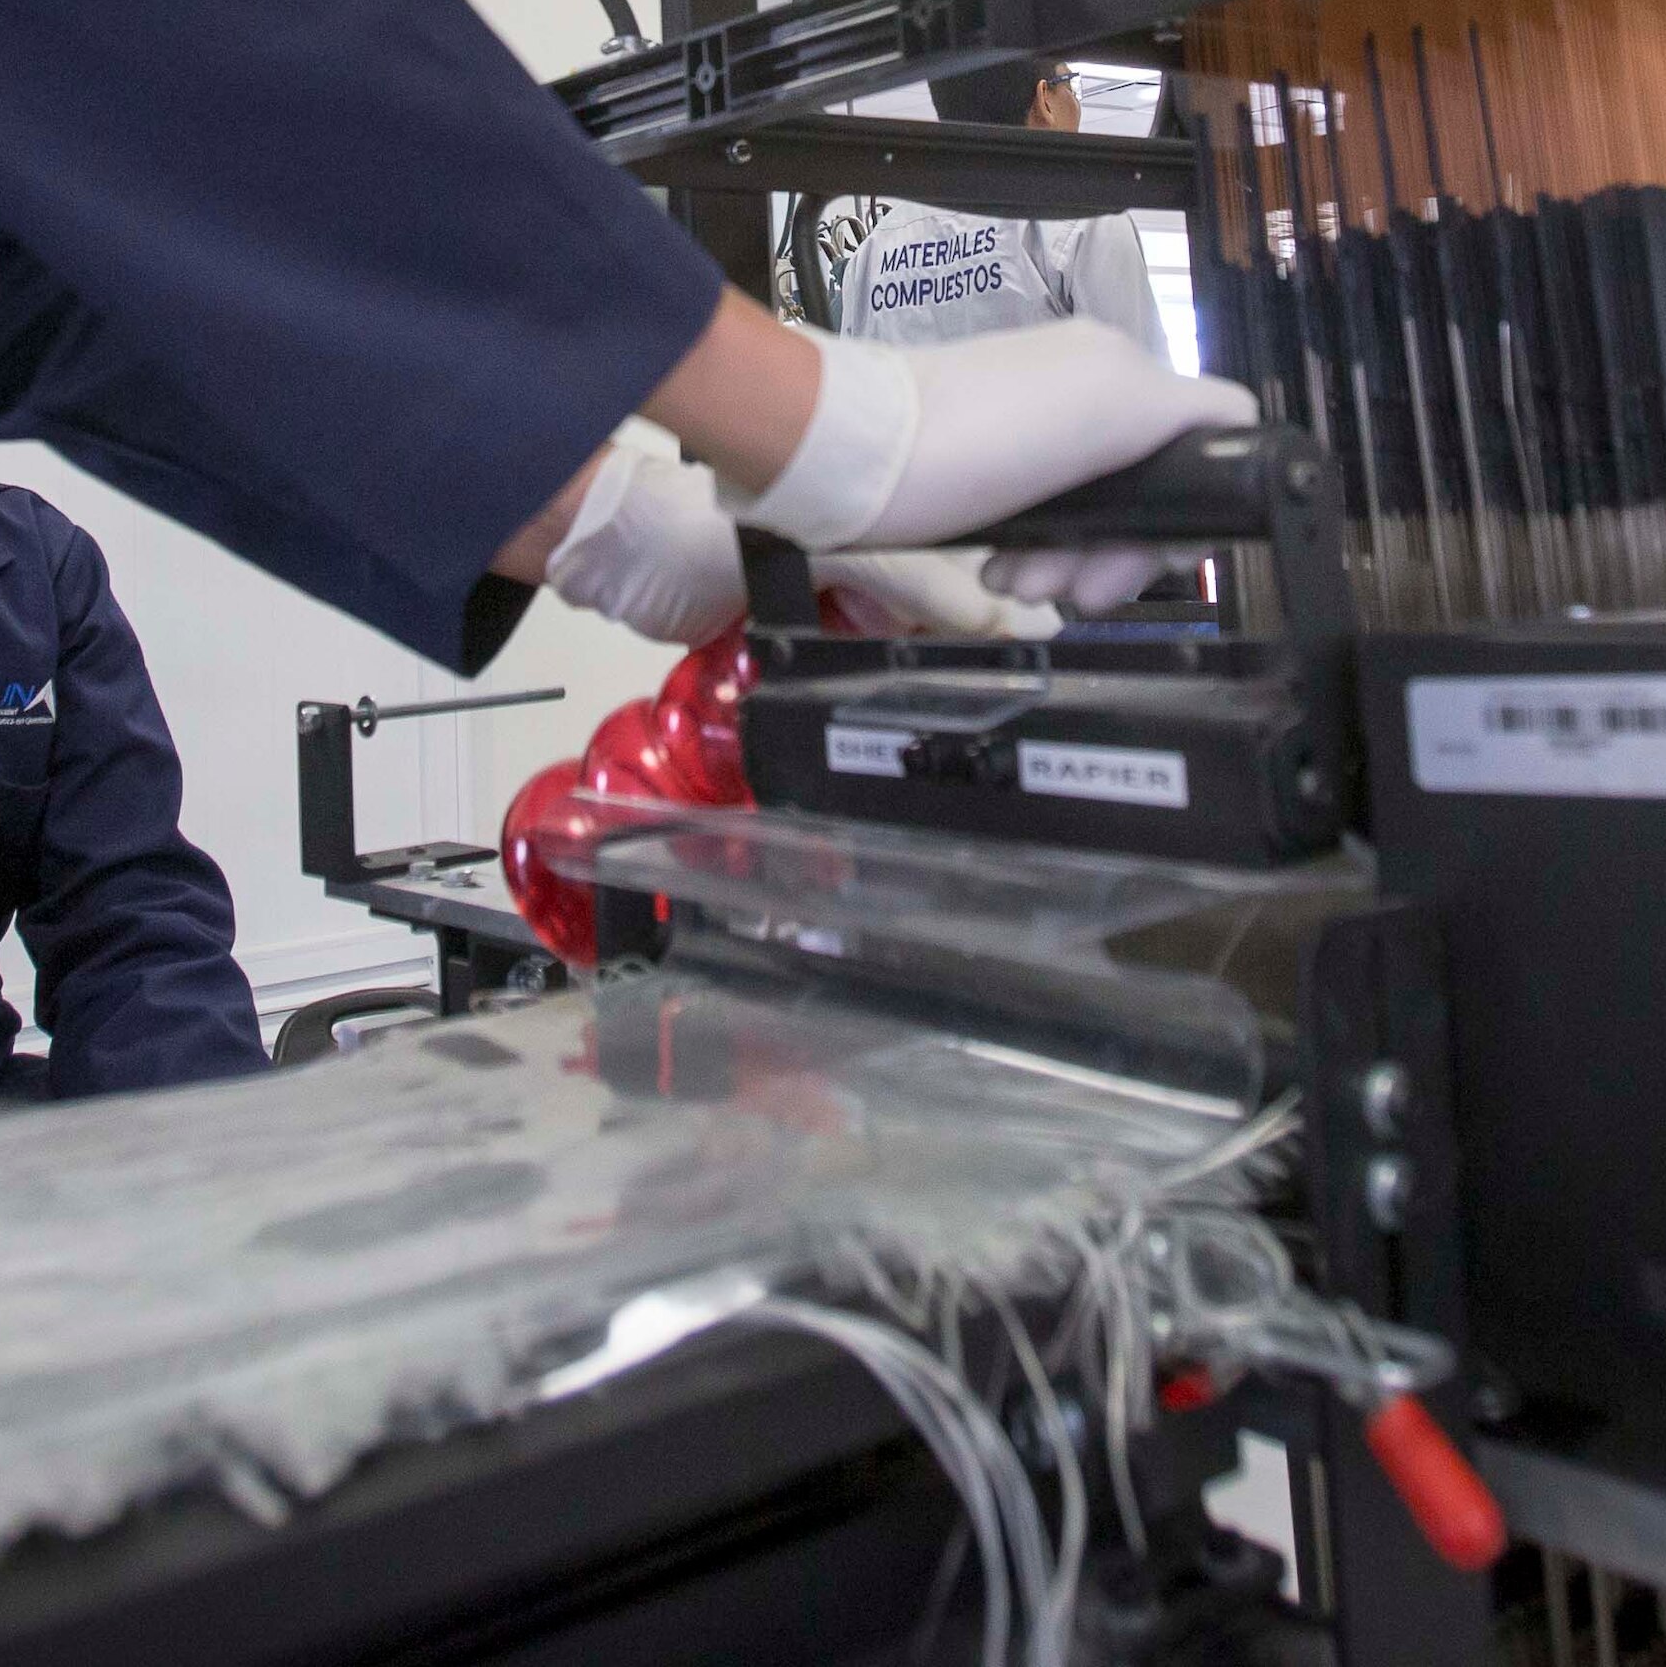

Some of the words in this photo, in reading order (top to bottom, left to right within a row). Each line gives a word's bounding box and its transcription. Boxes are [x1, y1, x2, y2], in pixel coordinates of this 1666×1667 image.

[880, 226, 997, 275] MATERIALES
[871, 262, 1002, 312] COMPUESTOS
[1027, 753, 1172, 791] RAPIER
